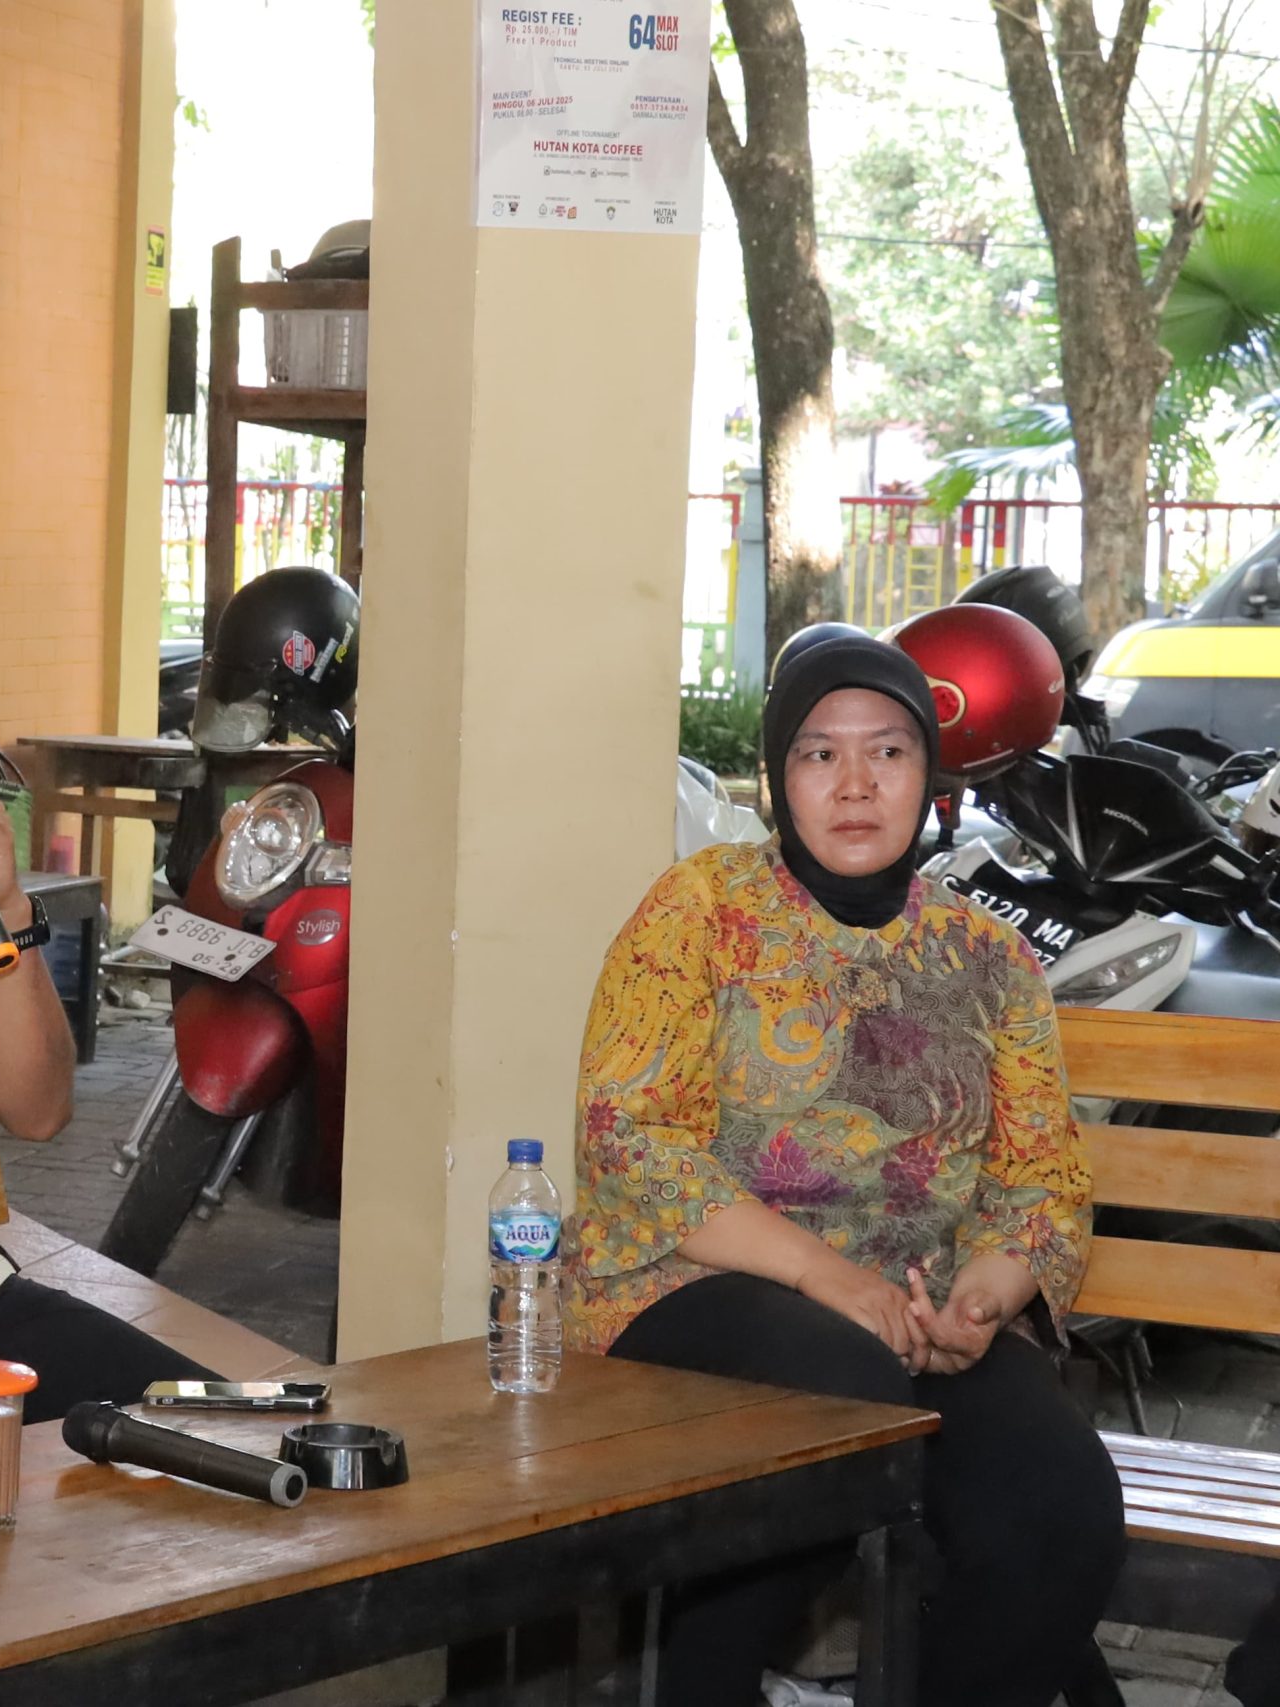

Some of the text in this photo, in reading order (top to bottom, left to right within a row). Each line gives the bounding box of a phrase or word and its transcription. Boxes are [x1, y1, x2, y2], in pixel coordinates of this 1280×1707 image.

[502, 9, 548, 24] REGIST
[552, 12, 574, 26] FEE
[656, 15, 679, 33] MAX
[629, 14, 656, 50] 64
[506, 35, 526, 45] Free
[540, 36, 577, 48] Product
[656, 34, 679, 51] SLOT
[492, 89, 533, 100] MAIN EVENT
[537, 97, 554, 106] JULI
[556, 95, 574, 104] 2025
[538, 106, 567, 115] SELESAI
[556, 129, 620, 138] OFFLINE TOURNAMENT
[534, 140, 643, 156] HUTAN KOTA COFFEE
[653, 207, 677, 217] HUTAN
[656, 216, 674, 224] KOTA
[1103, 807, 1149, 837] HONDA
[296, 919, 341, 935] Stylish
[1032, 918, 1074, 951] MA
[226, 937, 268, 960] JCB
[506, 1224, 551, 1244] AQUA
